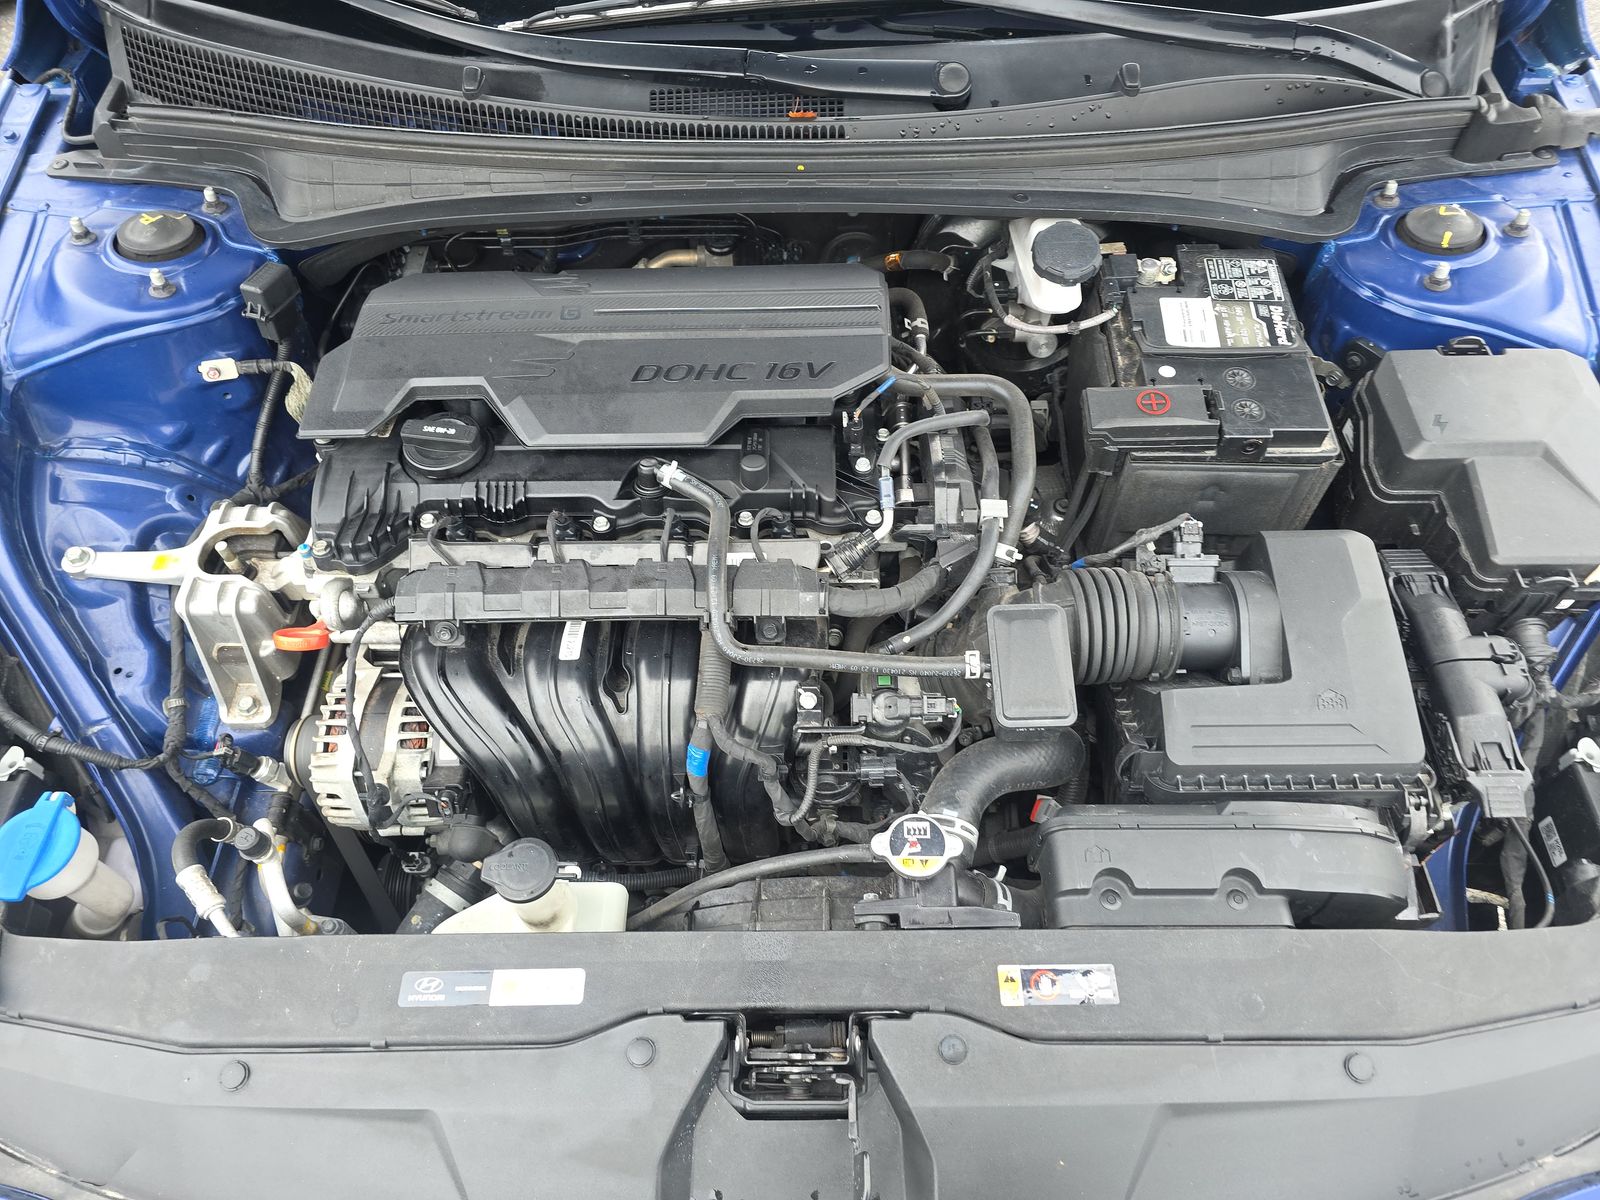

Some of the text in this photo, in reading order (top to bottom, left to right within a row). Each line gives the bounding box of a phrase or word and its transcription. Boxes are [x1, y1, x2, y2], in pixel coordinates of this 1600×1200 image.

[380, 309, 553, 325] Smartstream
[1269, 305, 1293, 346] DieHard
[631, 360, 837, 383] DOHC 16V
[422, 425, 436, 433] SAE
[407, 993, 446, 1002] HYUNDAI
